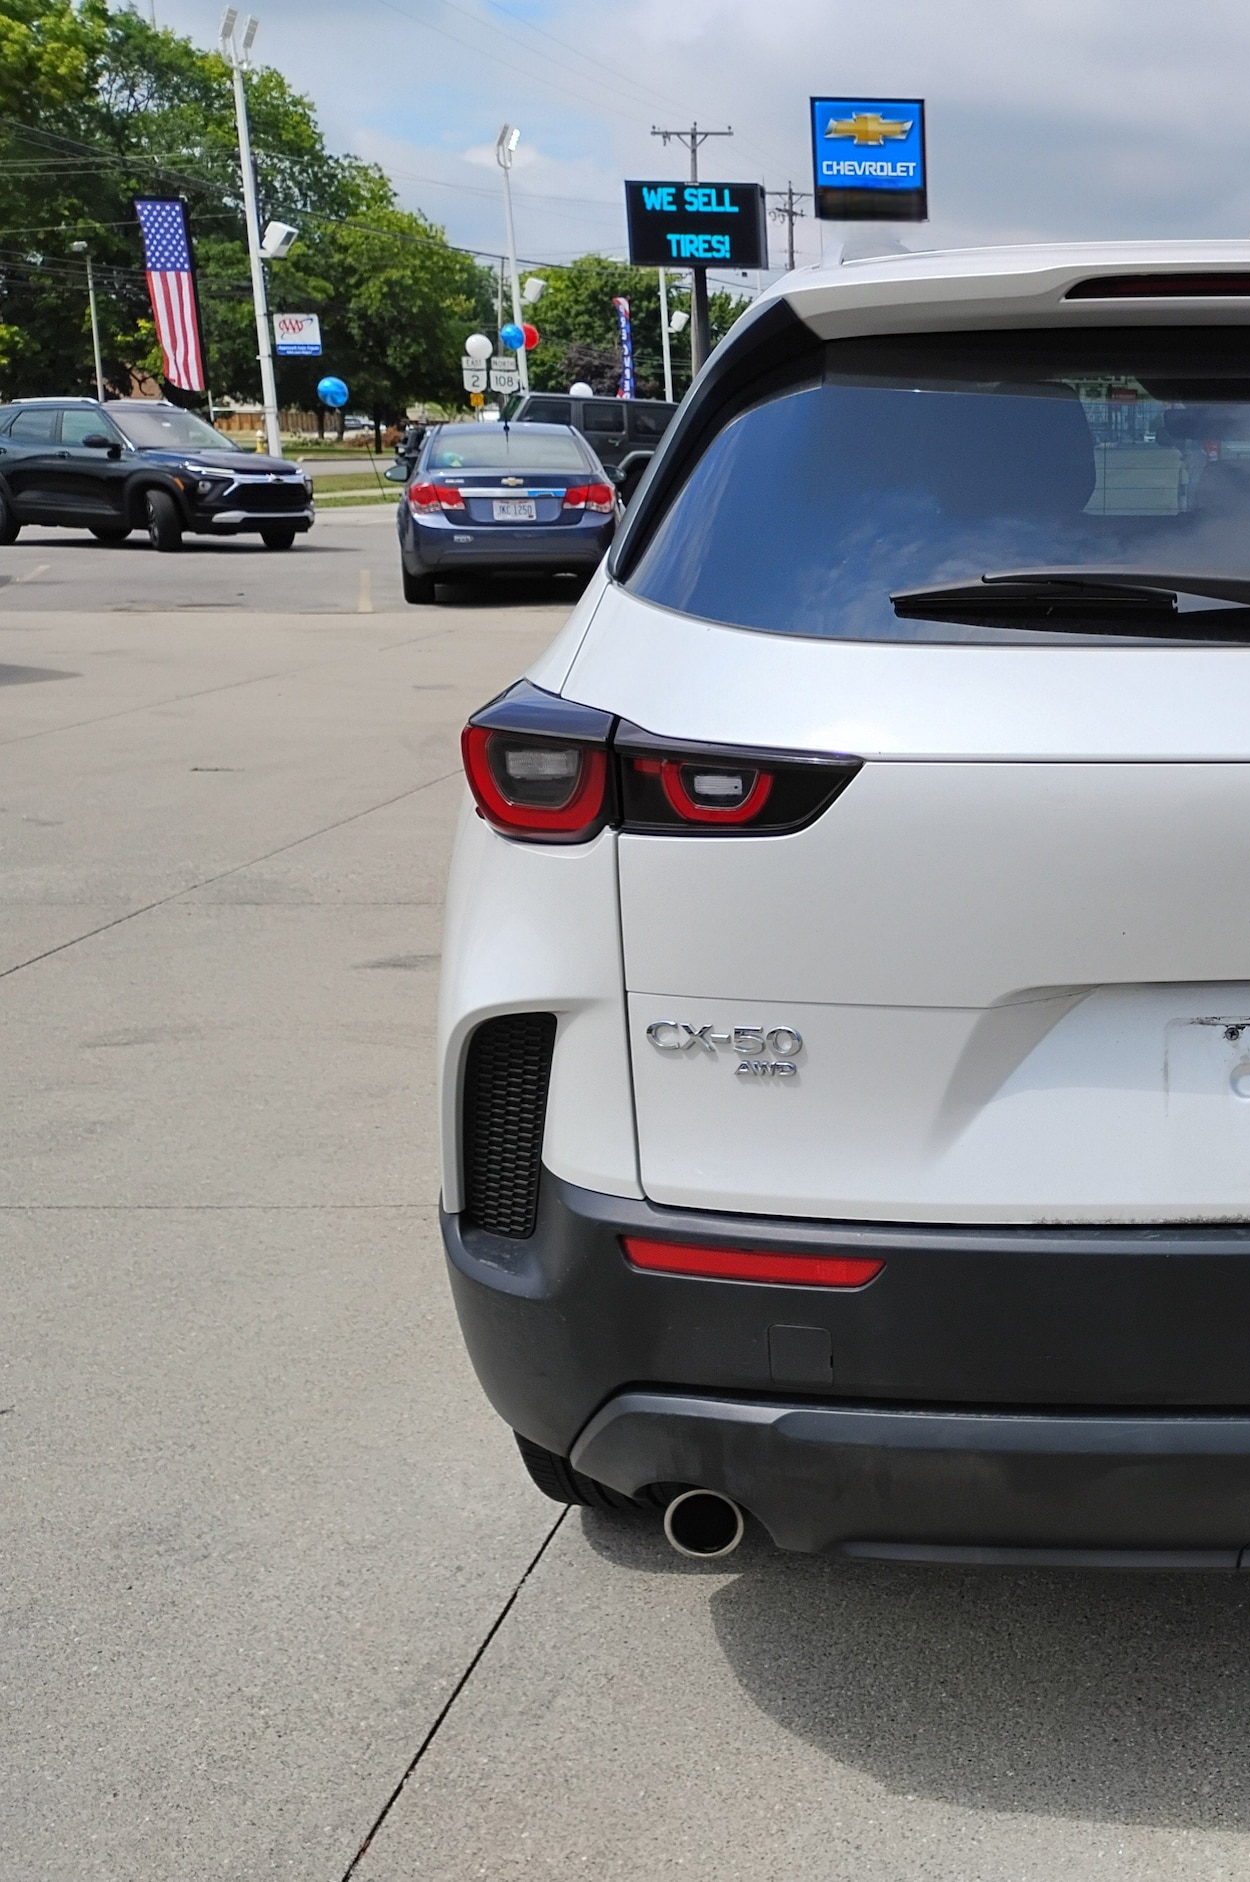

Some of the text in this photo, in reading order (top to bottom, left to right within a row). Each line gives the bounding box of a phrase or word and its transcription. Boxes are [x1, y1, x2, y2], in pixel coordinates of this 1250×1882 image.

[822, 161, 917, 177] CHEVROLET
[642, 187, 739, 212] WE SELL
[667, 234, 731, 259] TIRES!
[466, 359, 482, 367] EAST
[493, 360, 515, 368] NORTH
[472, 375, 480, 388] 2
[495, 376, 513, 387] 108
[514, 505, 532, 516] 1250
[646, 1020, 803, 1057] CX-50
[734, 1060, 797, 1077] AWD
